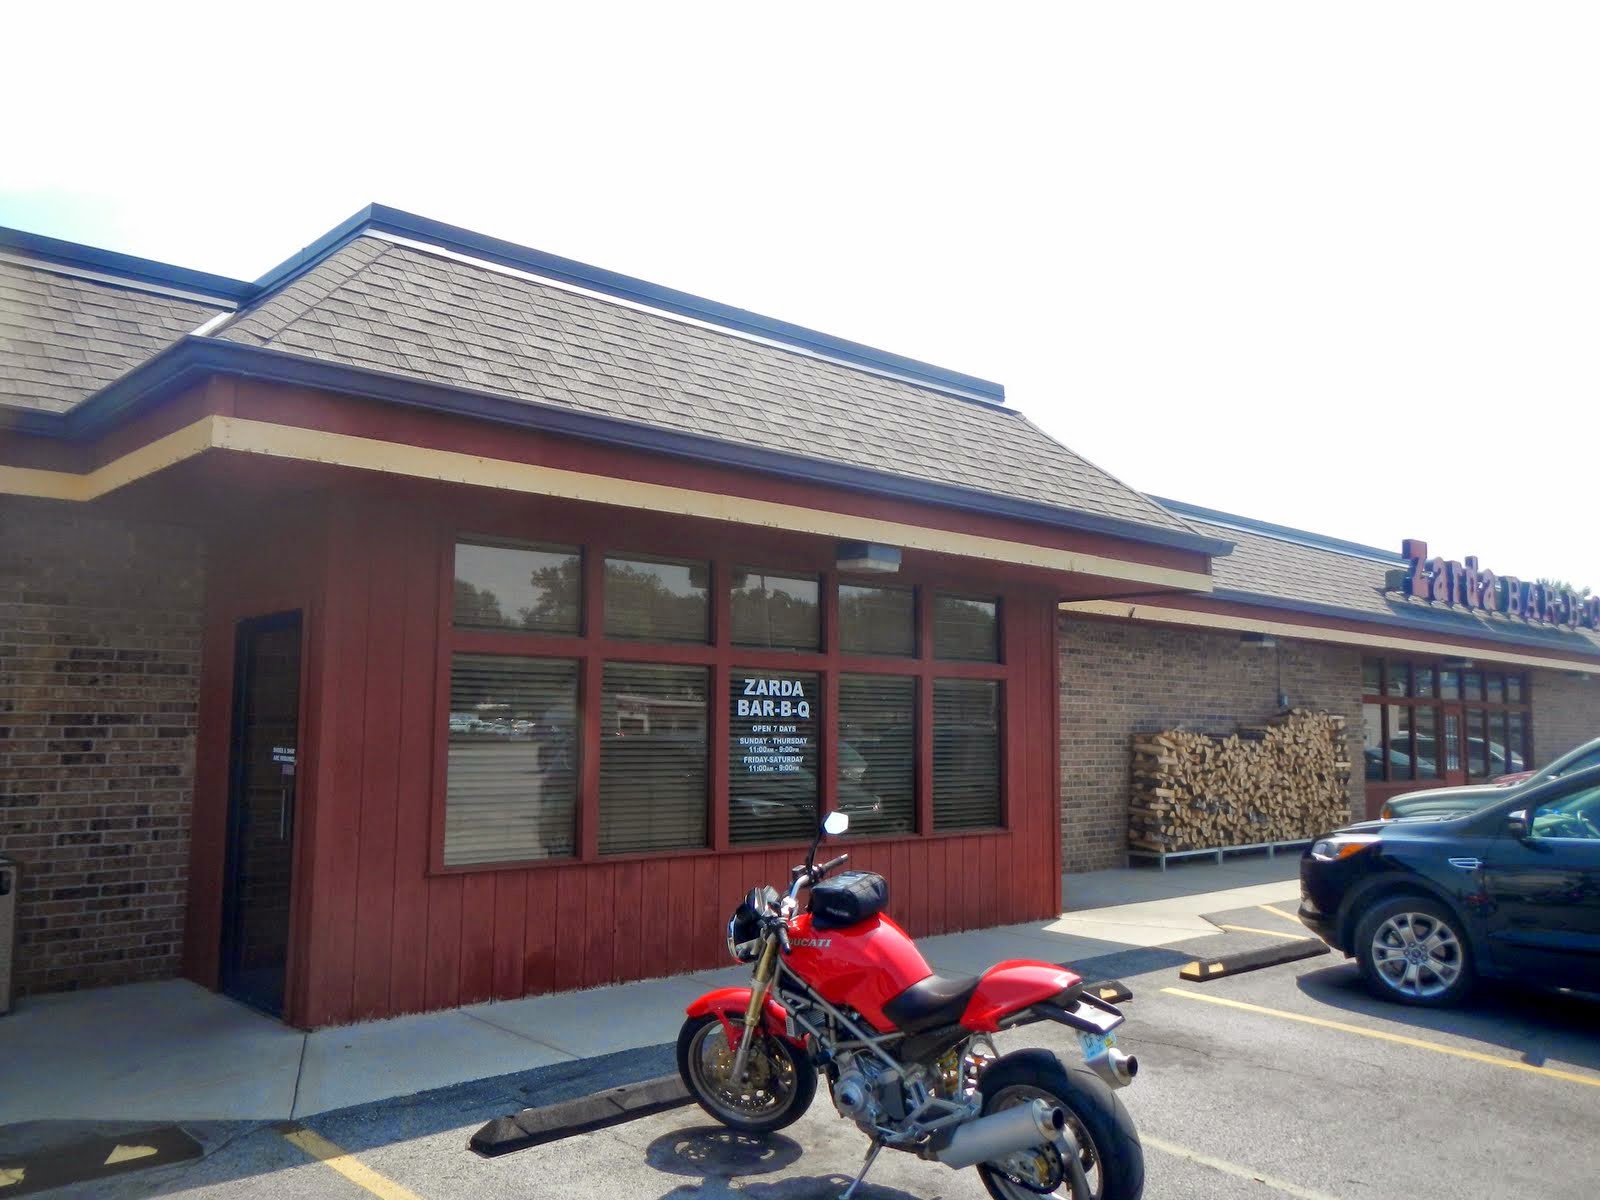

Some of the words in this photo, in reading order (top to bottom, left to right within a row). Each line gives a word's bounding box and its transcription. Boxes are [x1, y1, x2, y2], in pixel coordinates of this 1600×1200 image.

[1402, 539, 1499, 611] Zarda
[743, 678, 804, 697] ZARDA
[737, 699, 810, 719] BAR-B-Q
[743, 756, 804, 764] FRIDAY-SATURDAY
